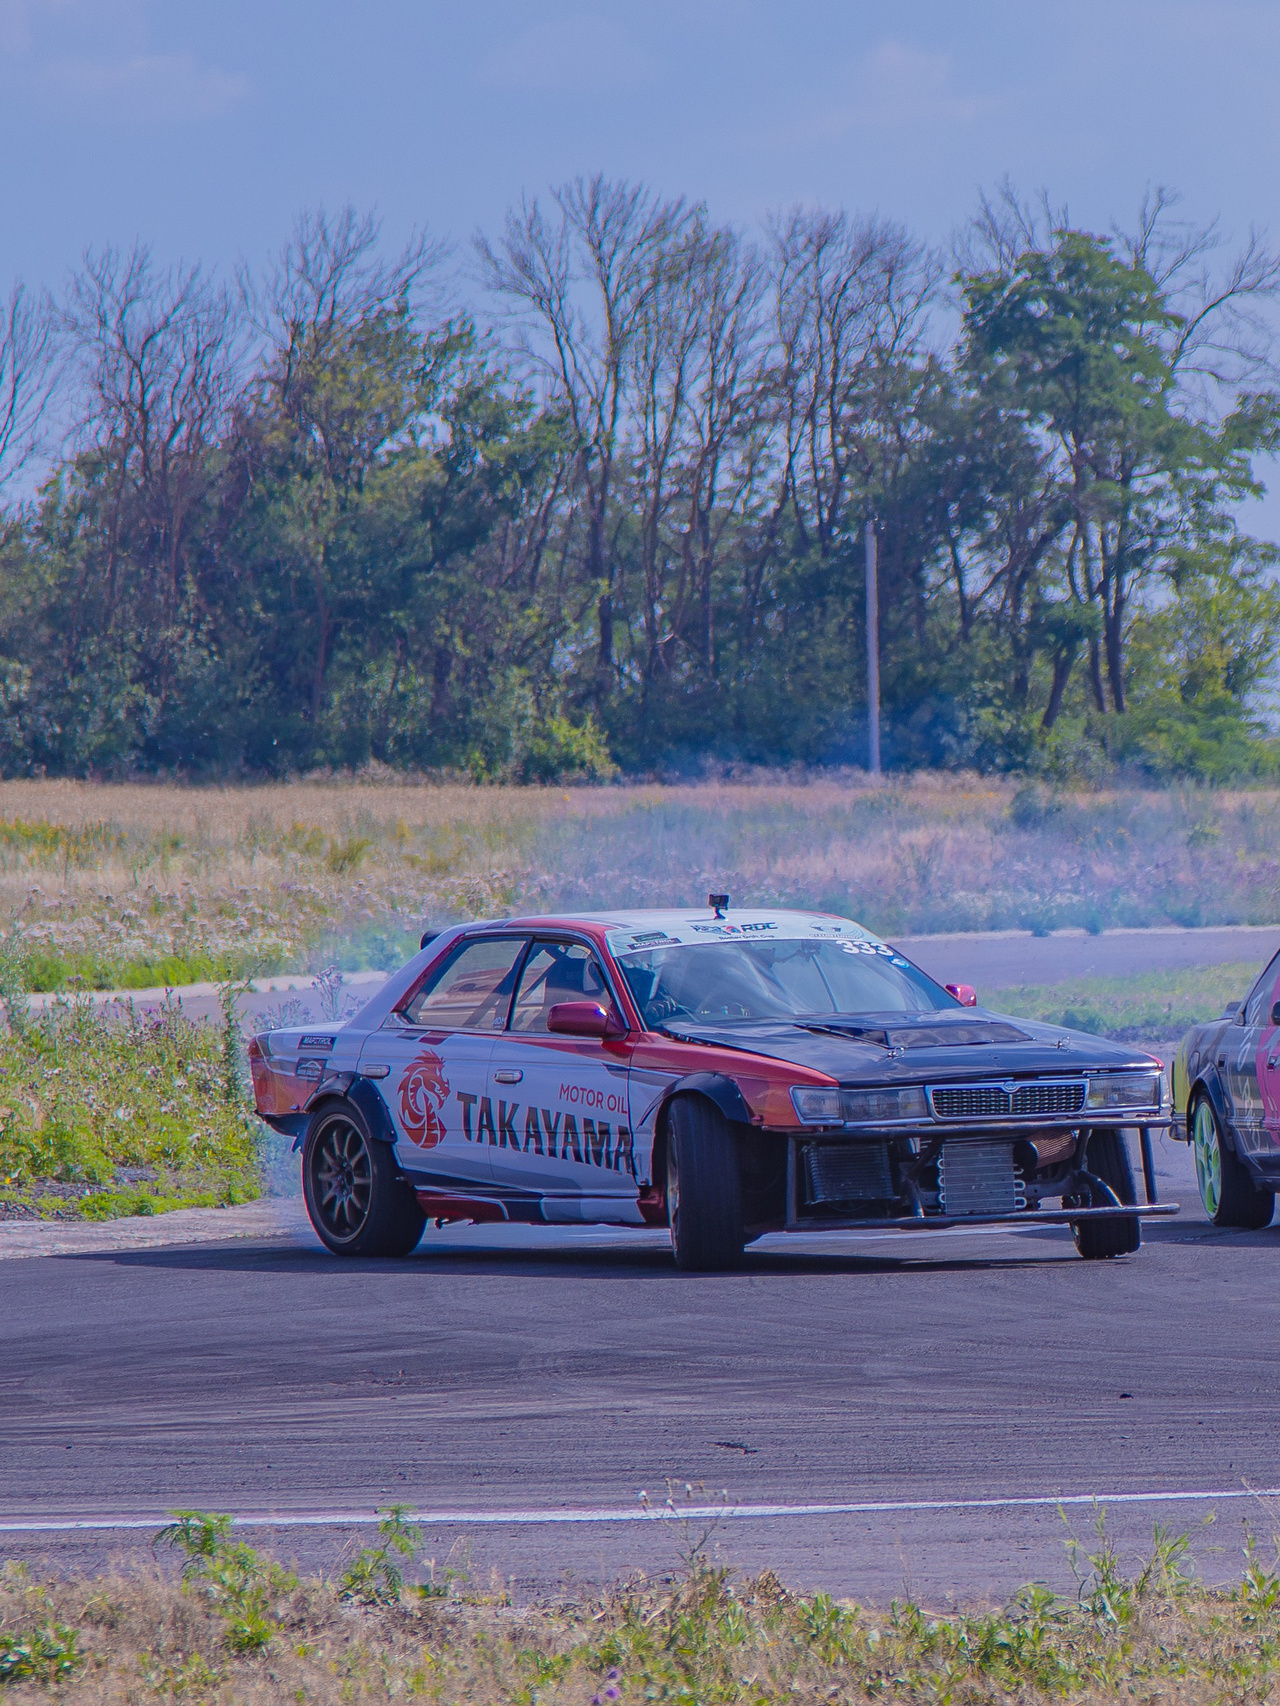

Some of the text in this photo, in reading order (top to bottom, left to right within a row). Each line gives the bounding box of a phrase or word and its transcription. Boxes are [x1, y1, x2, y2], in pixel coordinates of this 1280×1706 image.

[740, 922, 779, 933] RDC
[836, 940, 894, 957] 333
[559, 1083, 628, 1115] MOTOR OIL
[456, 1091, 637, 1175] TAKAYAMA
